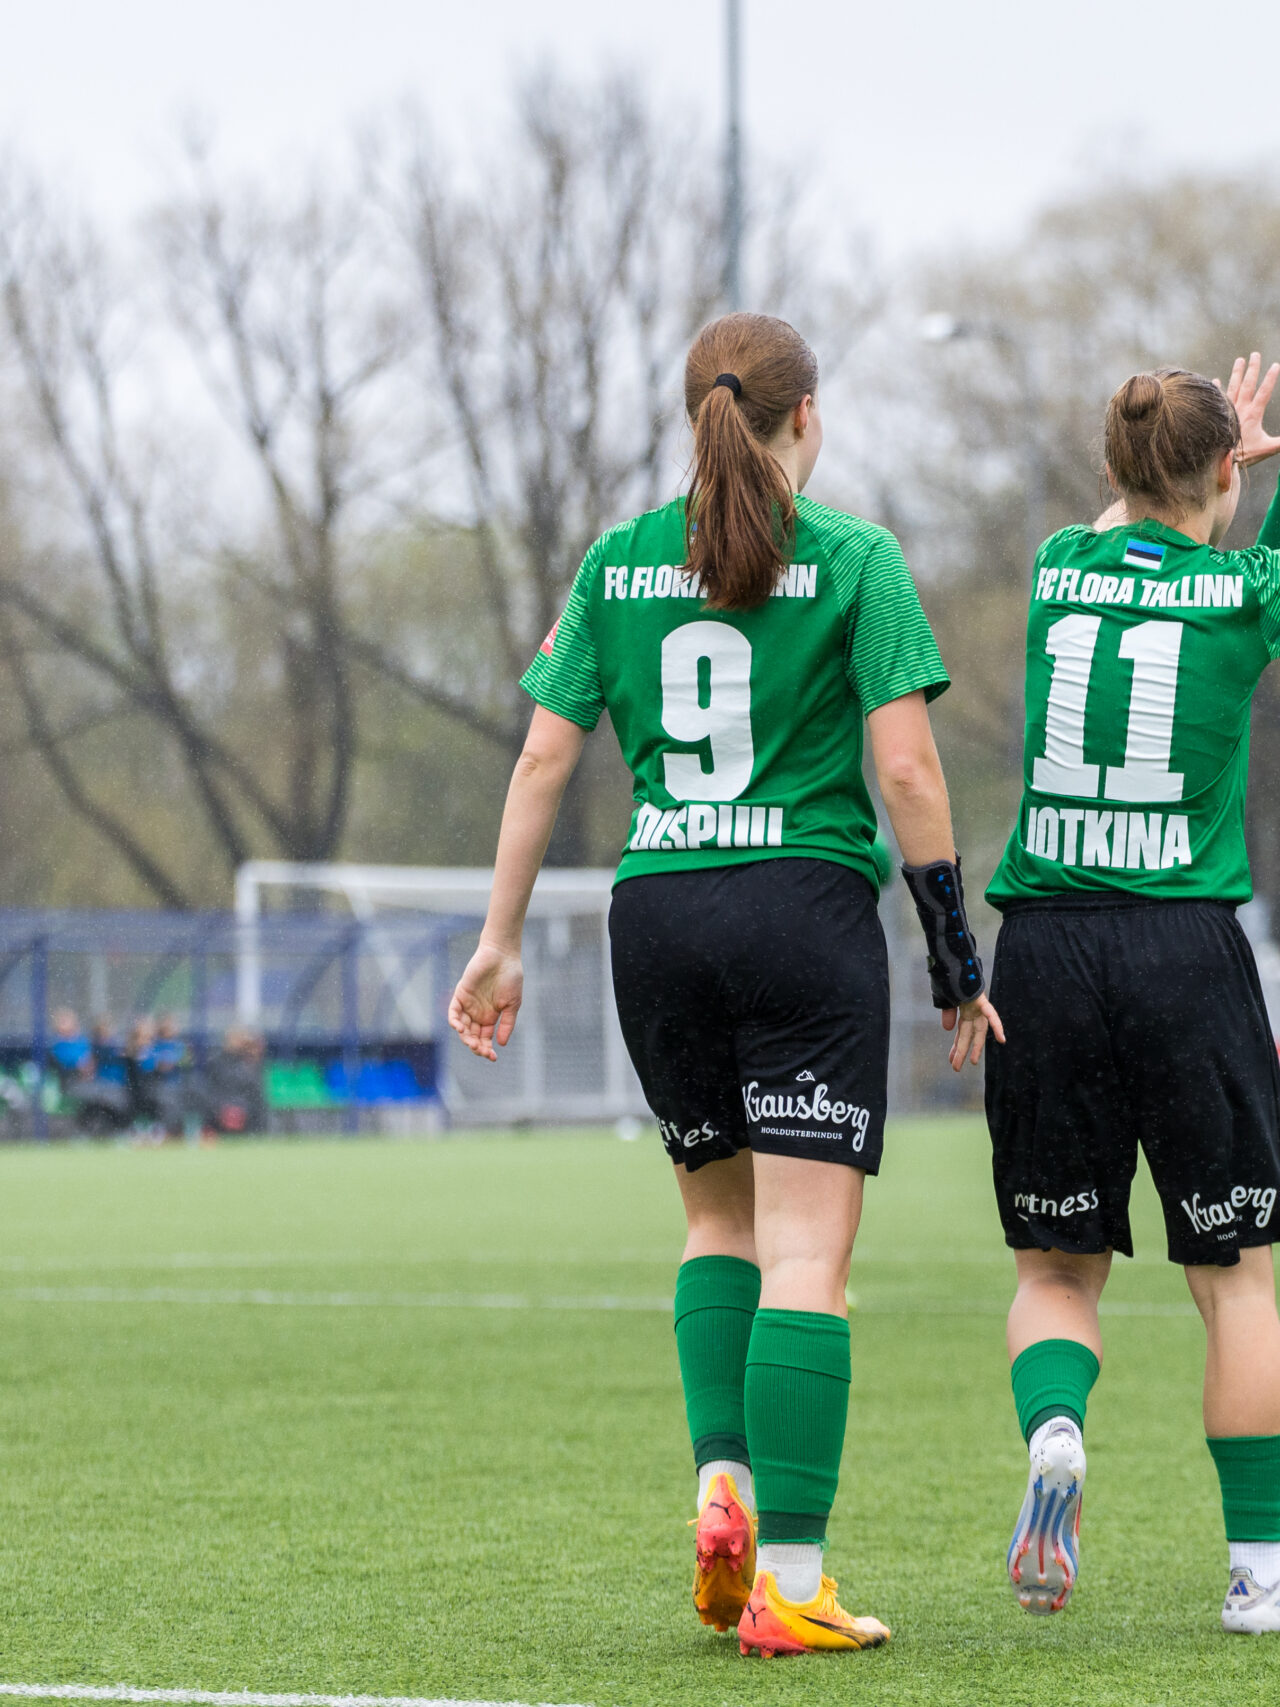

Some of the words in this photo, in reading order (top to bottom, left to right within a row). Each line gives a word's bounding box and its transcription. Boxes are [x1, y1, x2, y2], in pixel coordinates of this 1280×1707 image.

[604, 565, 629, 600] FC
[1035, 567, 1060, 600] FC
[1055, 568, 1135, 604] FLORA
[1139, 574, 1243, 607] TALLINN
[660, 620, 755, 802] 9
[1031, 614, 1185, 803] 11
[742, 1080, 870, 1152] Krausberg
[760, 1126, 843, 1140] HOOLDUSTEENINDUS
